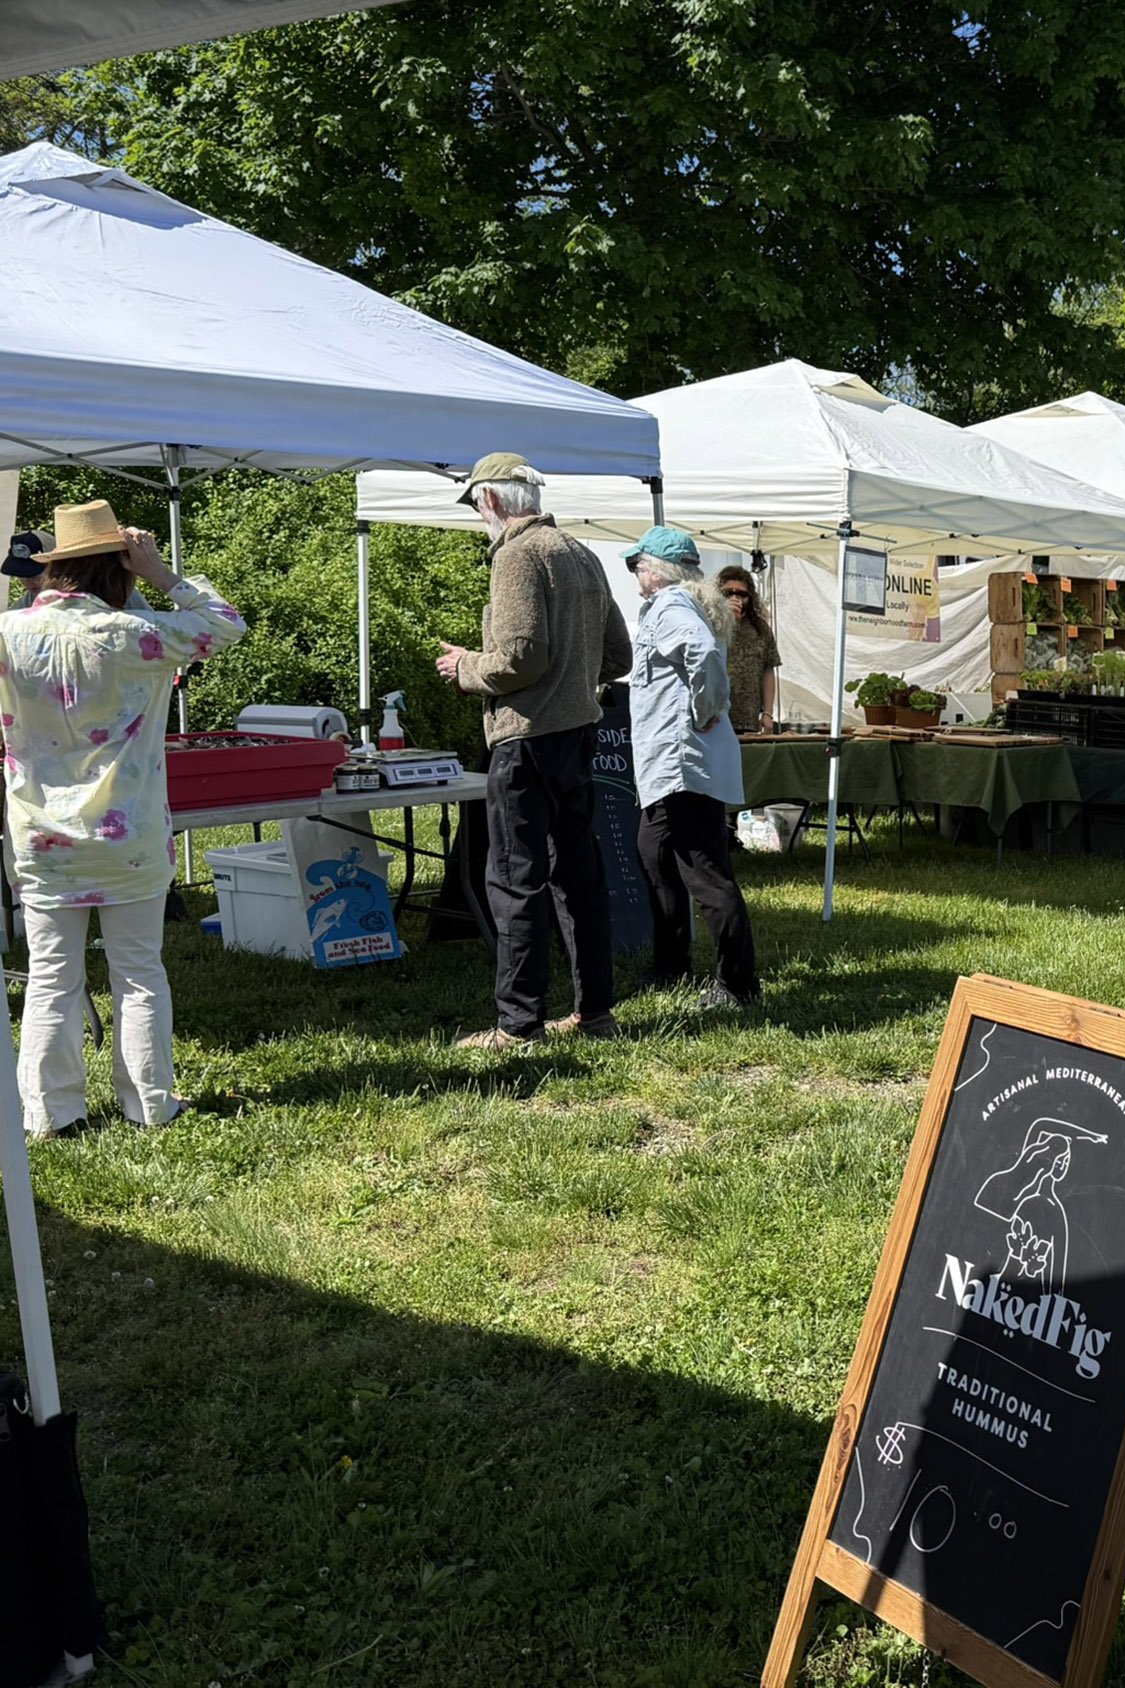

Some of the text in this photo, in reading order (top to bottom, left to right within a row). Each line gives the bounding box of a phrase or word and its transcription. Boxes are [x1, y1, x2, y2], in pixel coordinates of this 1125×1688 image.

[886, 600, 910, 613] Locally
[328, 942, 391, 958] and Sea Food
[333, 936, 383, 950] Fresh Fish
[981, 1074, 1039, 1121] ARTISANAL
[937, 1362, 1053, 1433] TRADITIONAL
[952, 1398, 1029, 1448] HUMMUS
